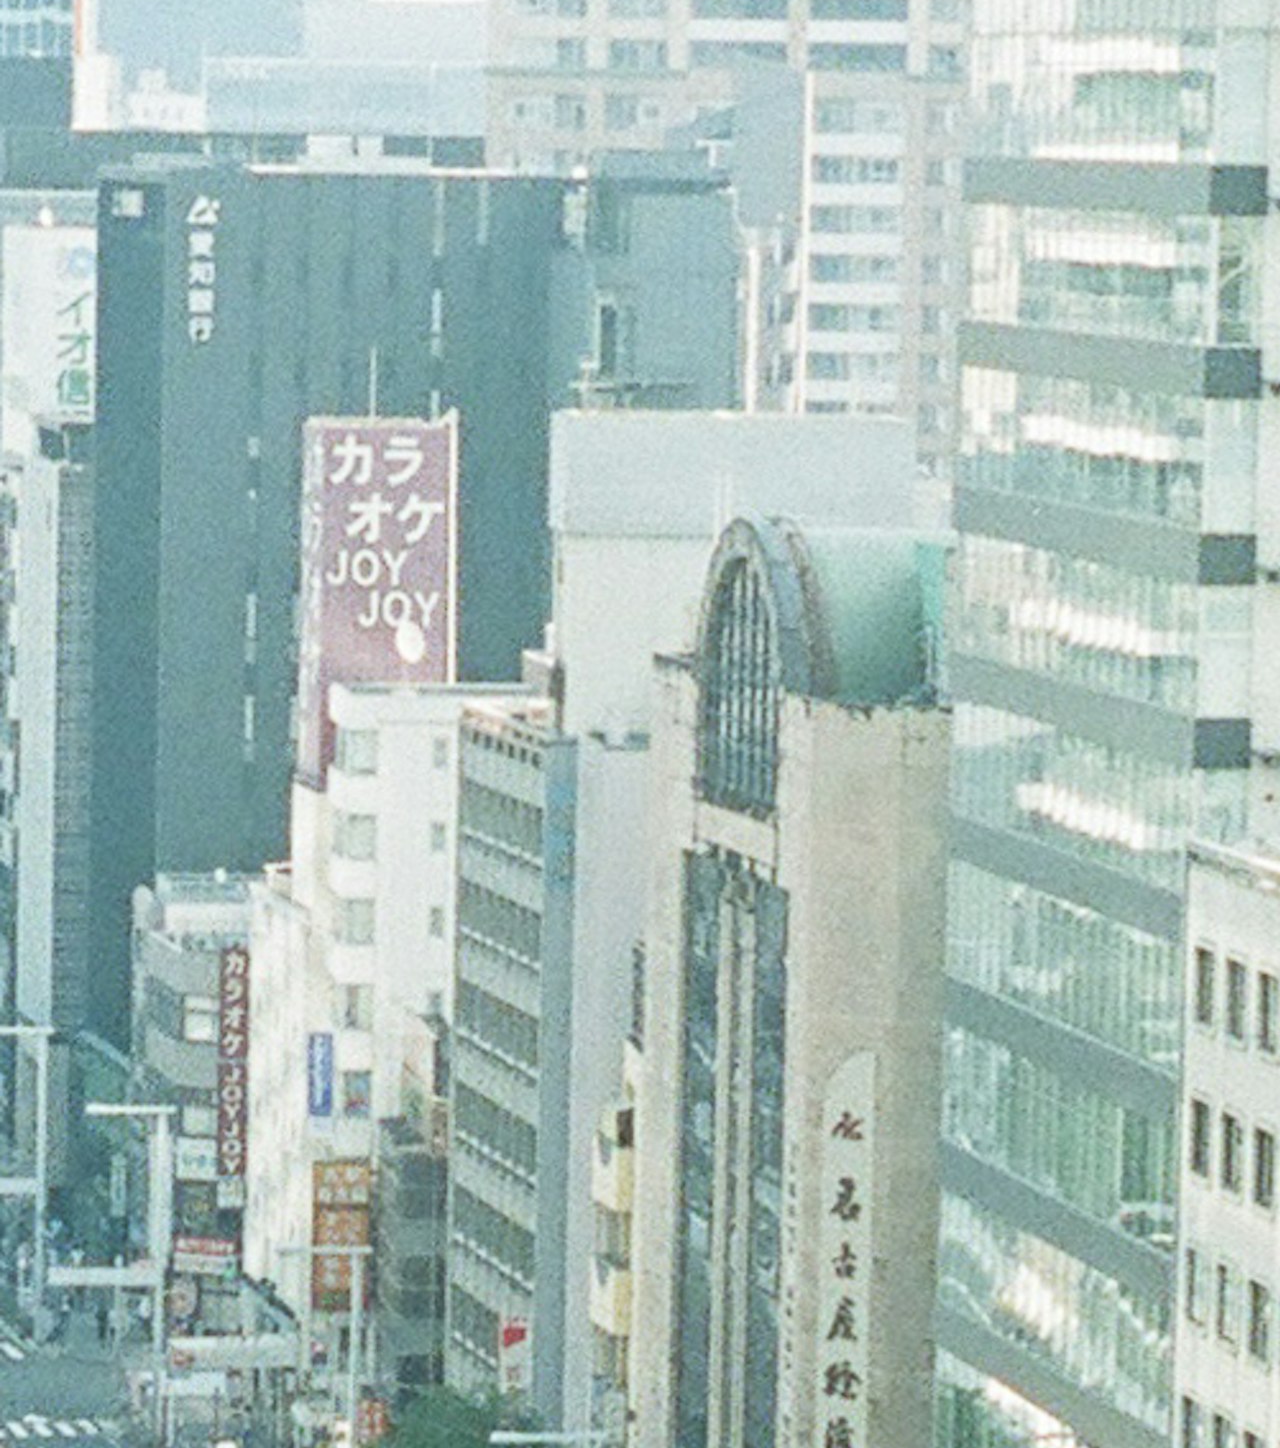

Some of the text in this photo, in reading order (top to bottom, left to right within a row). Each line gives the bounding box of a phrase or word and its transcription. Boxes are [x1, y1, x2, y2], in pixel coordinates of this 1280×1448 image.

[330, 434, 424, 487] カラ
[346, 492, 446, 544] オケ
[326, 549, 408, 587] JOY
[358, 589, 440, 629] JOY
[223, 953, 247, 1055] カラオケ
